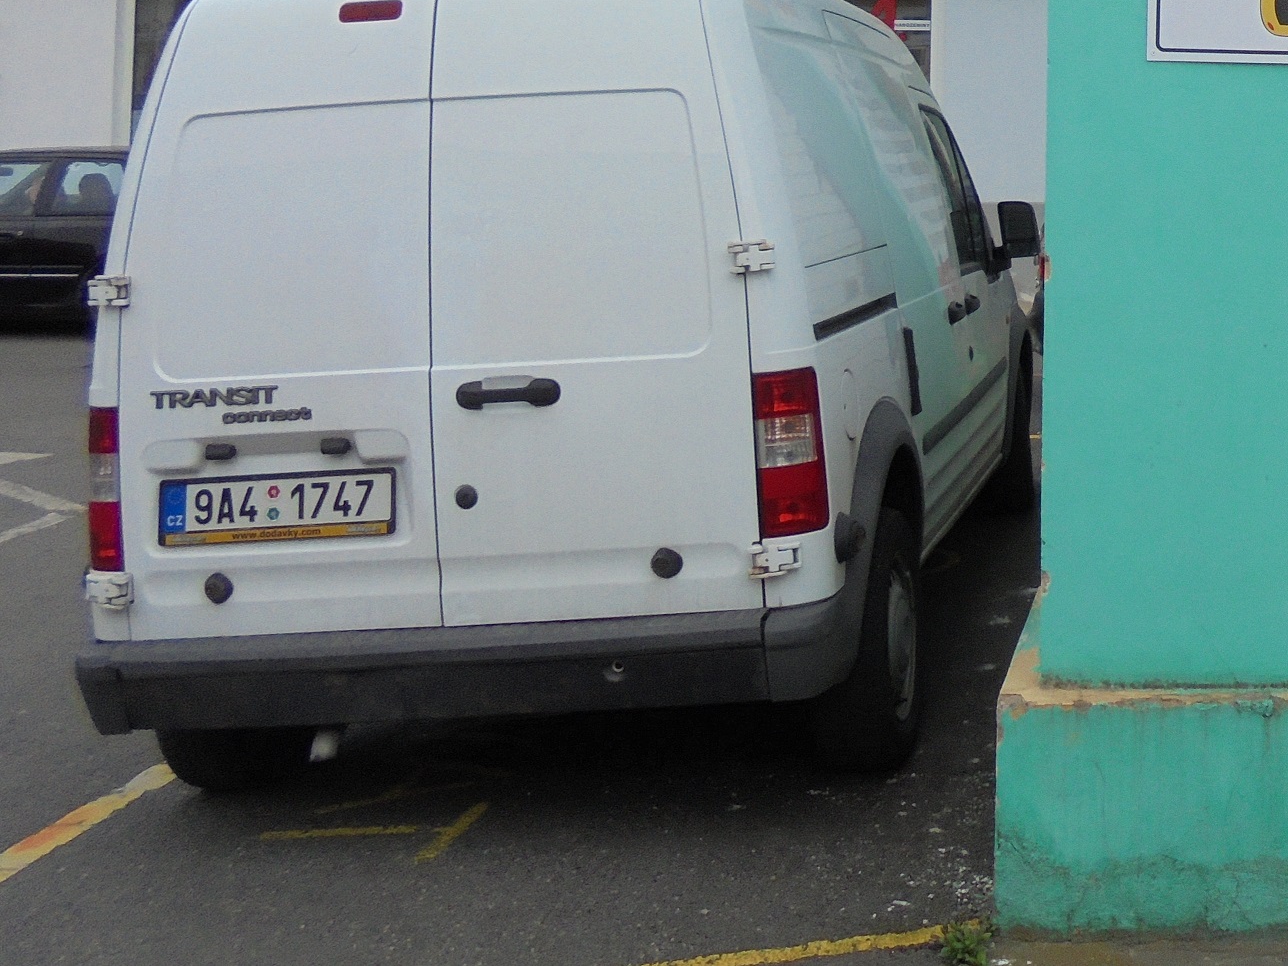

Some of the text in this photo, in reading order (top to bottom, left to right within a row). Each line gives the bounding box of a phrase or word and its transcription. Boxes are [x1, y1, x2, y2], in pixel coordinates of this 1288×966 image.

[150, 384, 279, 409] TRANSIT
[221, 406, 313, 425] connect
[193, 479, 375, 525] 9A4 1747
[166, 513, 183, 527] CZ
[231, 527, 322, 541] www.dodavky.com
